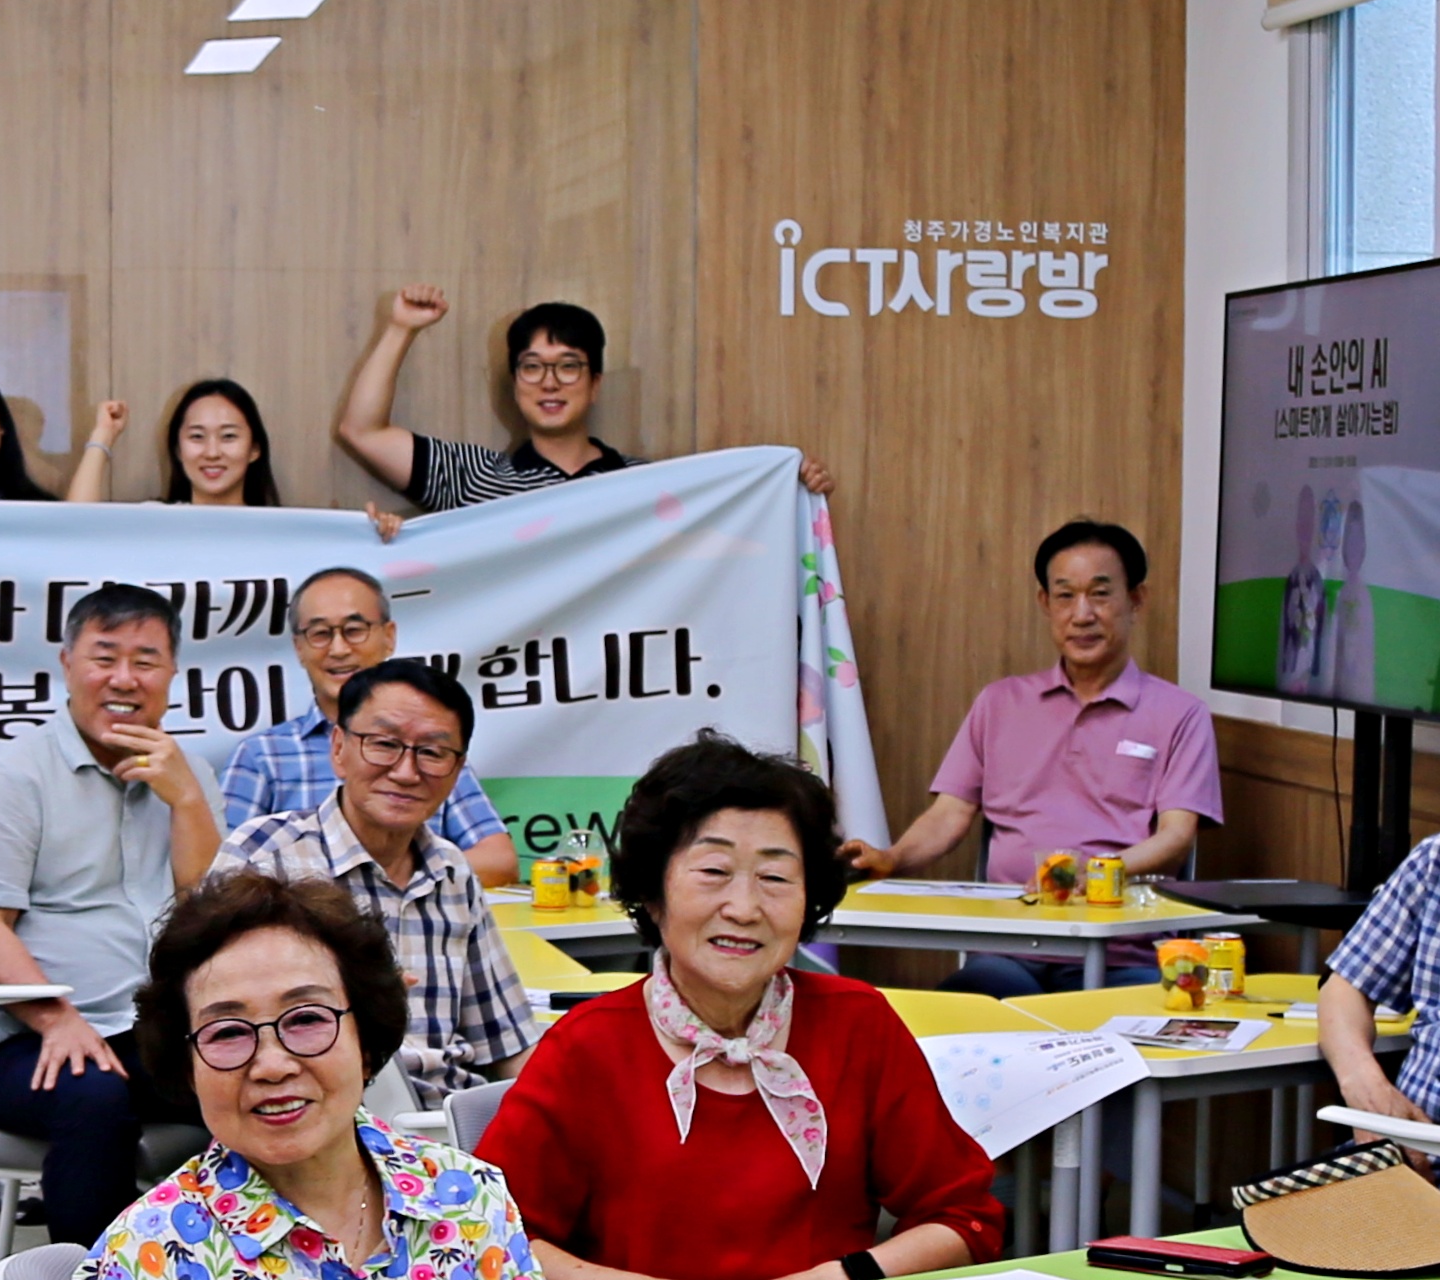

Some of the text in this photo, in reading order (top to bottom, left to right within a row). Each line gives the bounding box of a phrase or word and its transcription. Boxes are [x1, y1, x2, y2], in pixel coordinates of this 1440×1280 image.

[903, 219, 1110, 245] 청주가경노인복지관
[1288, 337, 1389, 398] 내 손안의 AI
